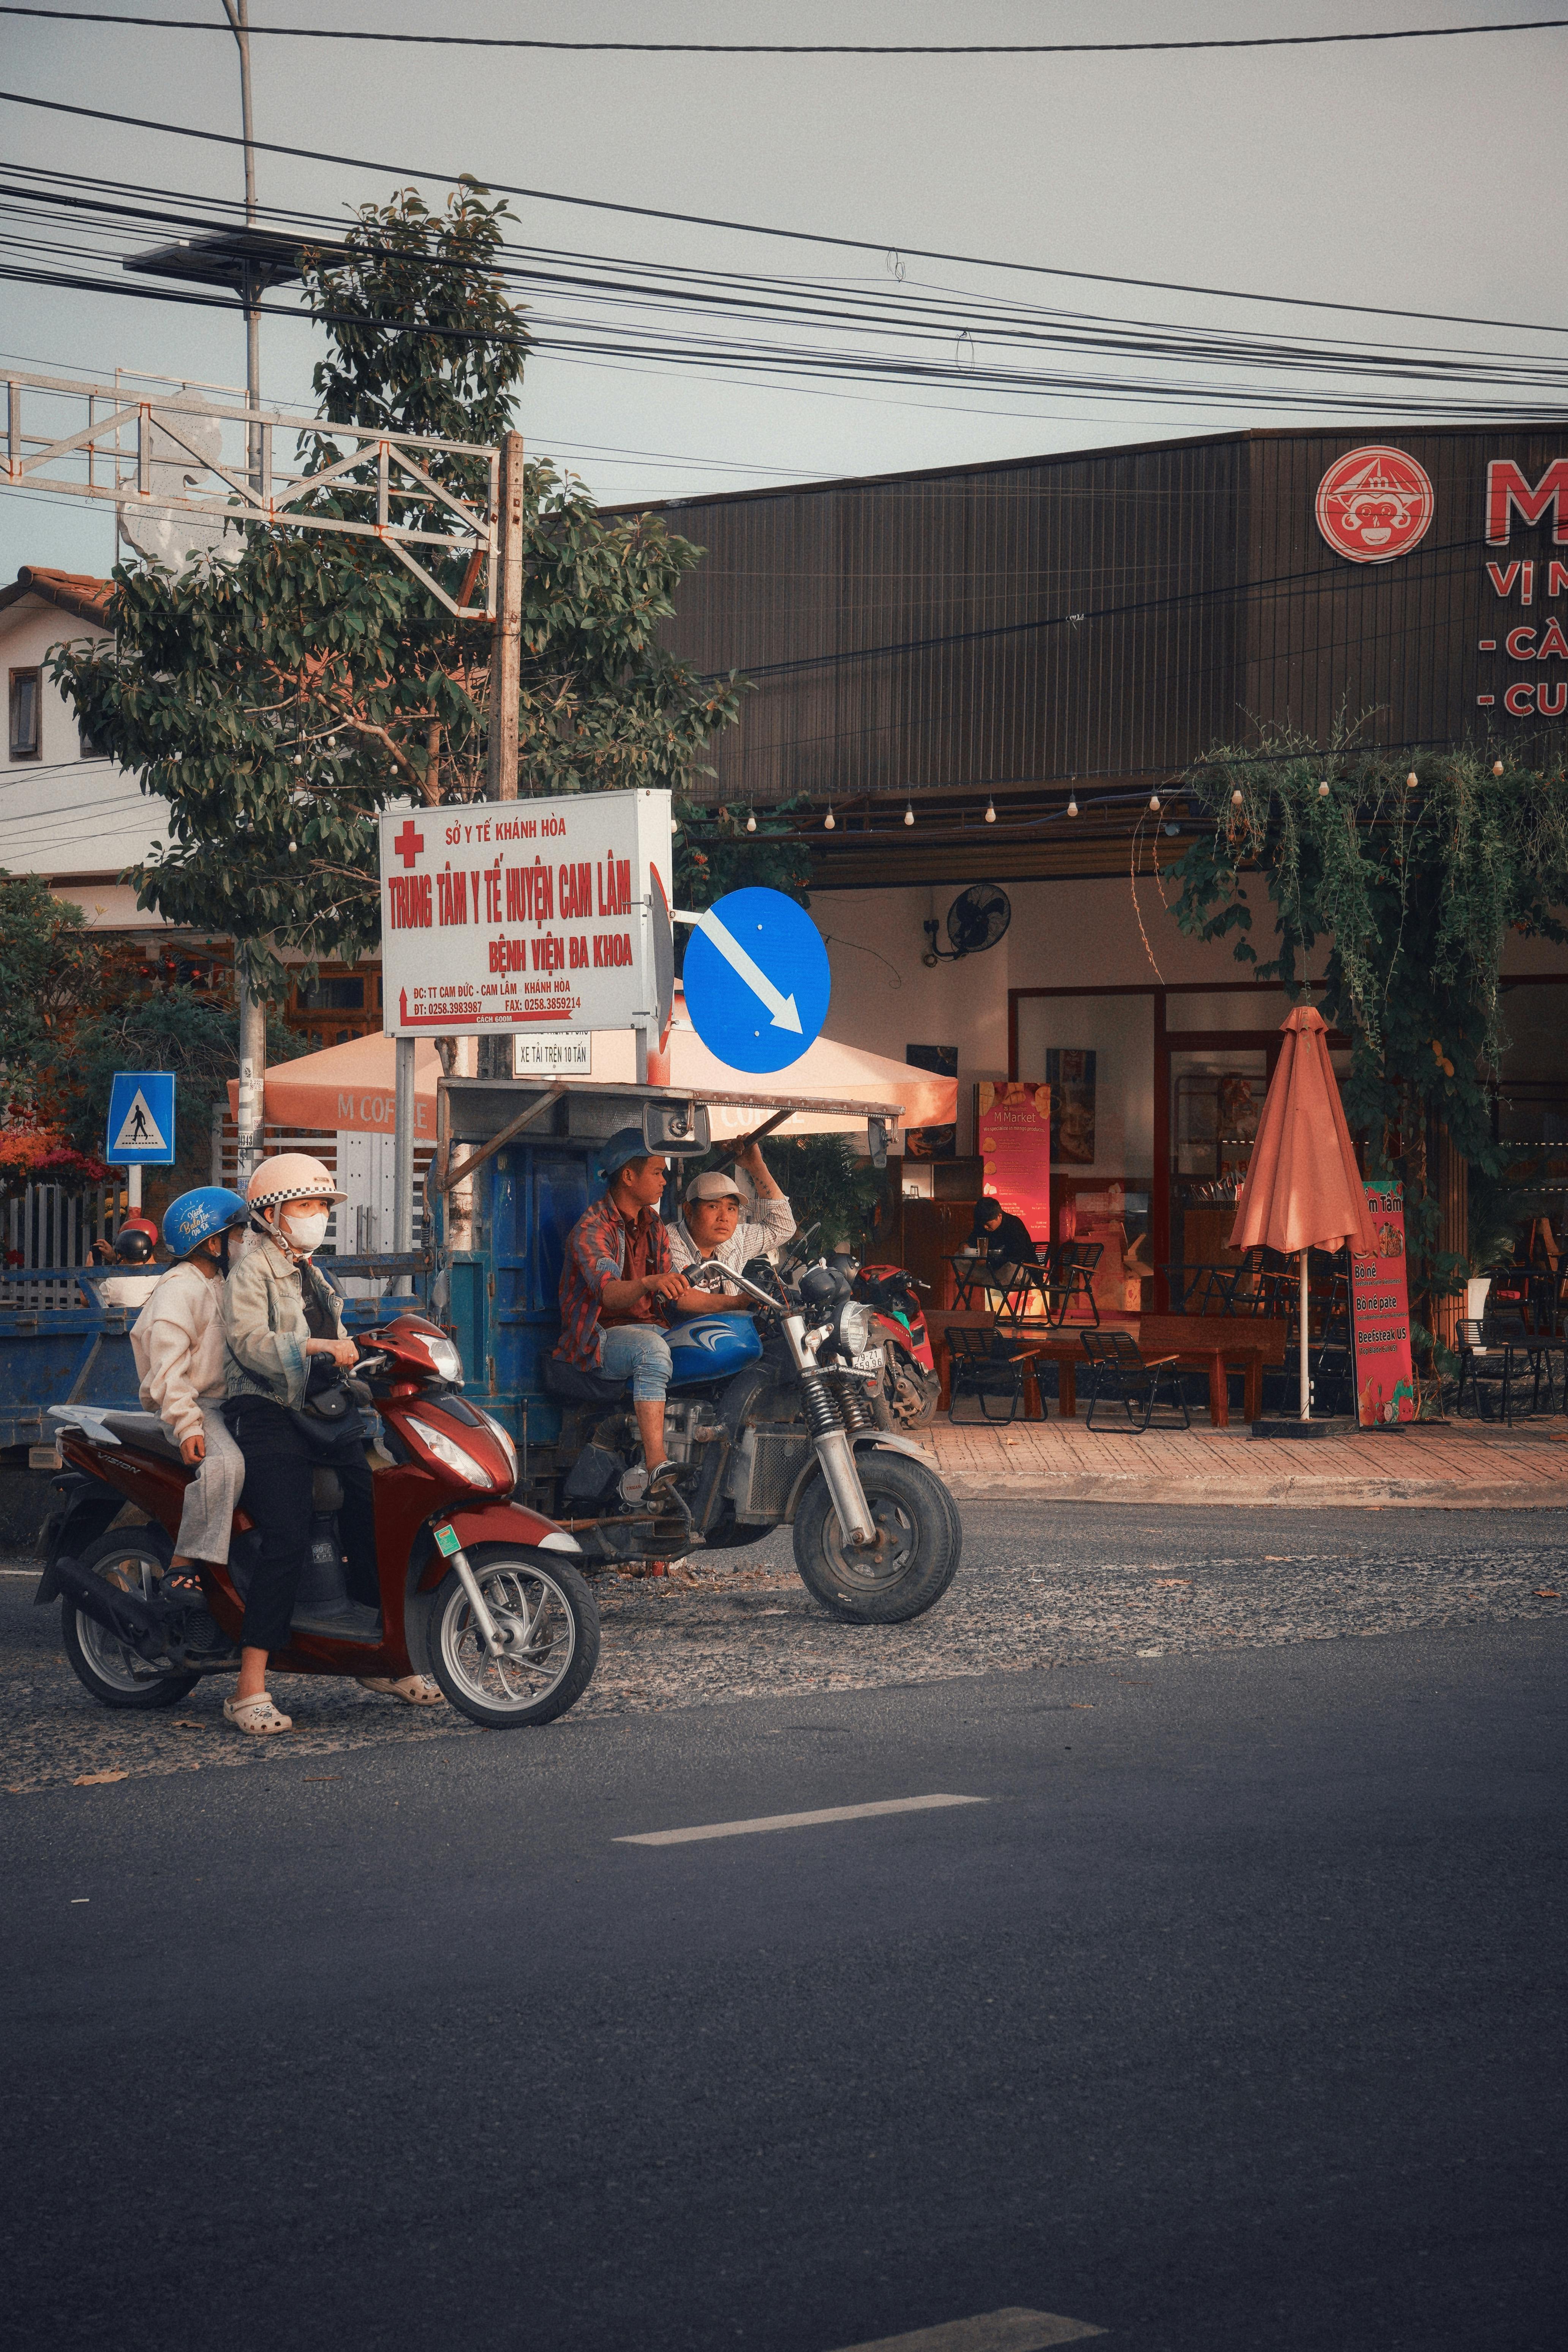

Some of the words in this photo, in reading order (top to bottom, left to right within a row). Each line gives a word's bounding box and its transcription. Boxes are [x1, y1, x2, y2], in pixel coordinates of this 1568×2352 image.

[1486, 459, 1568, 546] M
[1486, 560, 1533, 605] VỊ
[1506, 616, 1568, 660] CÀ
[1504, 683, 1567, 716] CU
[446, 820, 461, 845] SỞ
[465, 826, 472, 843] Y
[476, 817, 492, 842] TẾ
[496, 817, 536, 840] KHÁNH
[541, 812, 566, 837] HÒA
[389, 874, 432, 929] TRUNG
[437, 861, 467, 926] TÂM
[471, 871, 480, 924] Y
[484, 853, 504, 923] TẾ
[506, 855, 554, 929] HUYỆN
[559, 863, 593, 919] CAM
[597, 849, 631, 916] LÂM
[489, 934, 526, 978] BỆNH
[531, 931, 565, 976] VIỆN
[569, 936, 589, 969] ĐA
[593, 934, 633, 967] KHOA
[414, 988, 426, 999] ĐC:
[428, 987, 437, 998] TT
[439, 986, 456, 998] CAM
[458, 982, 474, 997] ĐỨC
[481, 984, 498, 996] CAM
[500, 980, 517, 995] LÂM
[525, 979, 551, 994] KHÁNH
[554, 977, 570, 992] HÒA
[414, 1004, 426, 1015] ĐT:
[428, 1001, 482, 1015] 0258.3983987
[505, 999, 522, 1011] FAX:
[525, 997, 581, 1010] 0258.3859214
[521, 1047, 530, 1062] XE
[532, 1042, 542, 1062] TẢI
[545, 1044, 562, 1062] TRÊN
[564, 1047, 571, 1062] 10
[574, 1041, 586, 1062] TẤN
[338, 1094, 354, 1119] M
[360, 1095, 428, 1129] COFE
[994, 1112, 1001, 1122] M
[1004, 1112, 1036, 1122] Market
[1380, 1191, 1402, 1213] Tâm
[1355, 1262, 1365, 1279] Bò
[1366, 1261, 1376, 1278] né
[1356, 1294, 1367, 1311] Bò
[1368, 1293, 1378, 1310] né
[1379, 1295, 1397, 1312] pate
[1358, 1328, 1396, 1344] Beefsteak
[1396, 1327, 1407, 1340] US
[1359, 1347, 1368, 1356] (Top
[1369, 1346, 1381, 1354] Blade
[854, 1358, 882, 1370] 559.96
[98, 1452, 141, 1474] VISION
